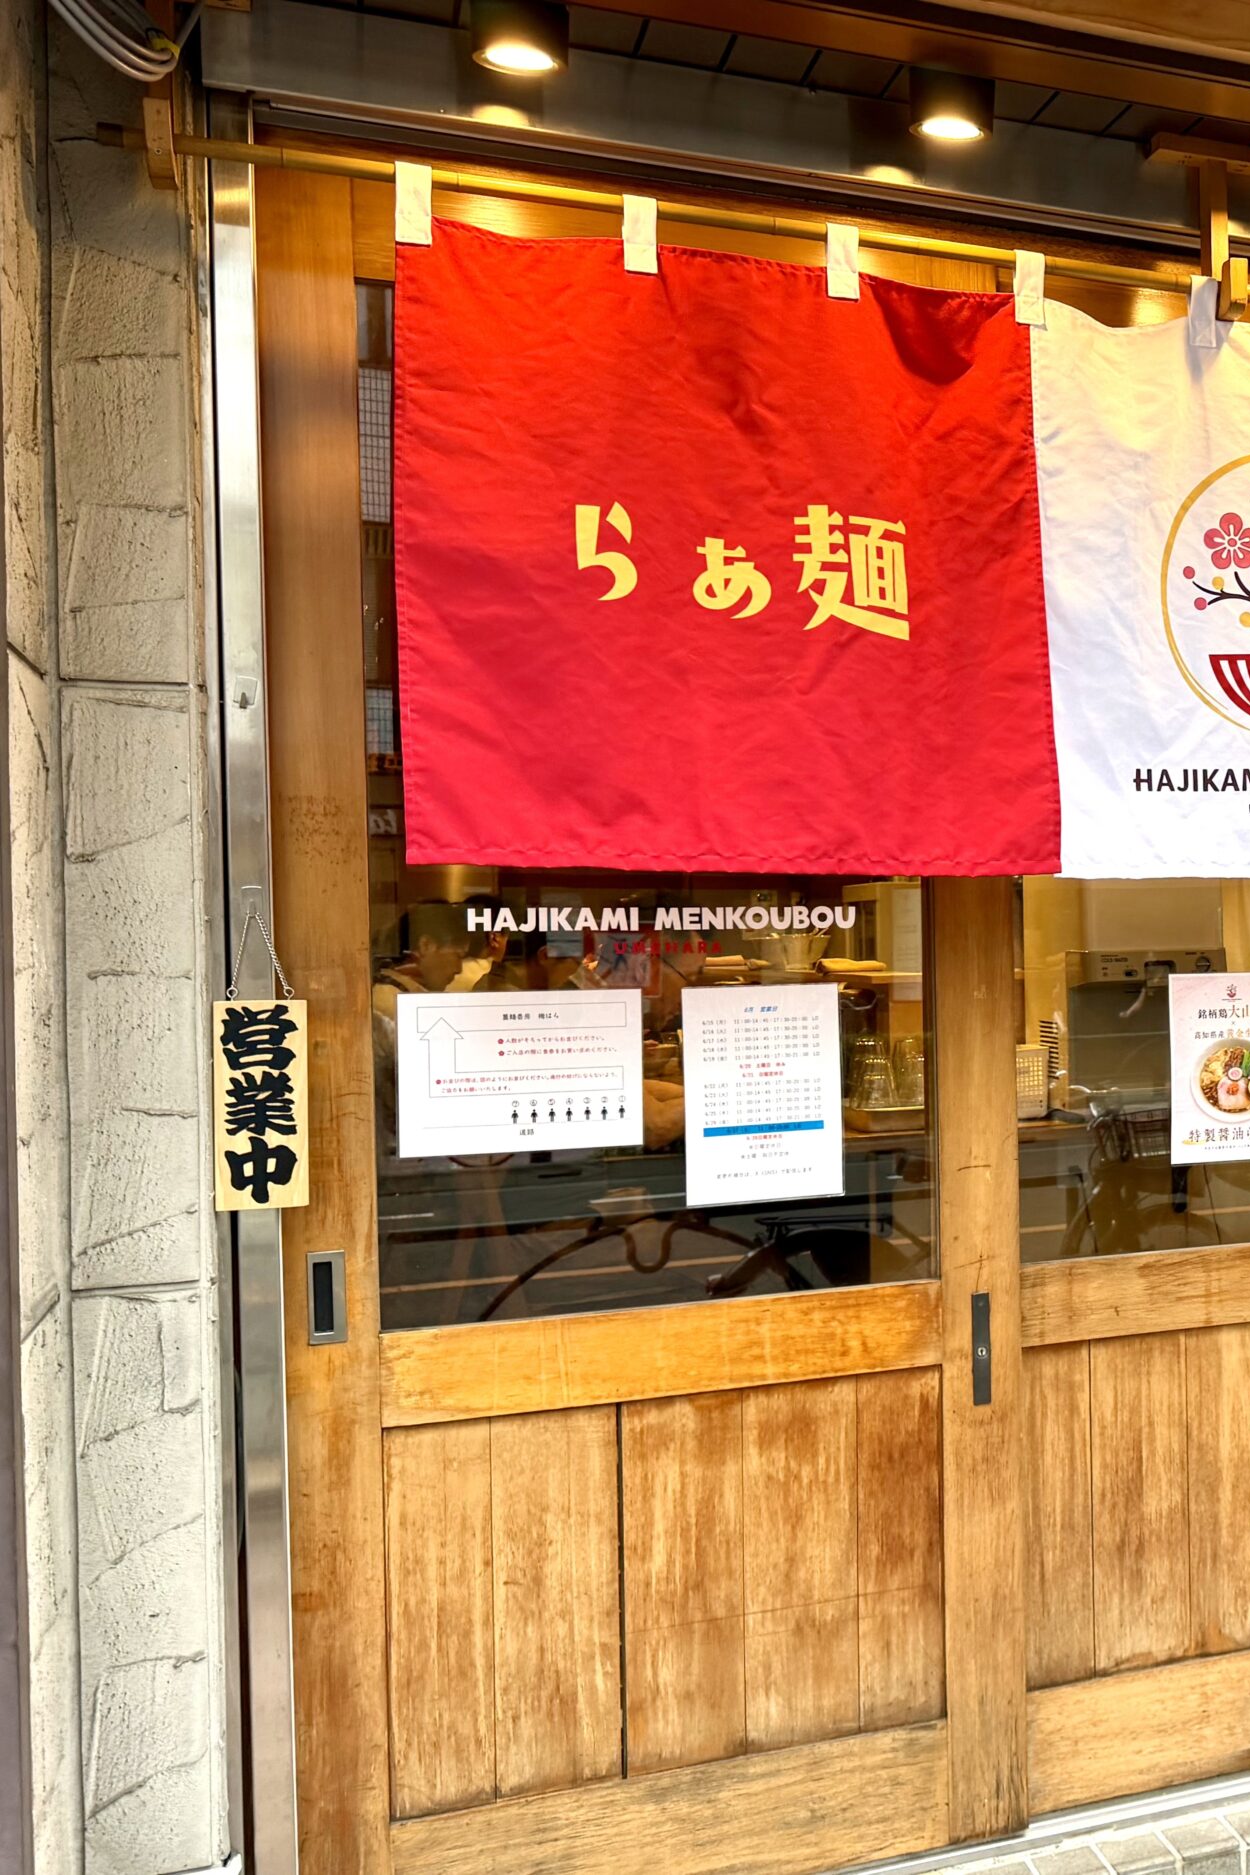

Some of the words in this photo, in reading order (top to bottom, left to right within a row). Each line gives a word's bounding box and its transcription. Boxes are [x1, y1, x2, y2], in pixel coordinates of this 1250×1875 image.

[575, 501, 910, 641] らぁ麺
[467, 907, 639, 932] HAJIKAMI
[653, 905, 857, 931] MENKOUBOU
[613, 940, 723, 956] UMEHARA
[220, 1004, 298, 1204] 営業中
